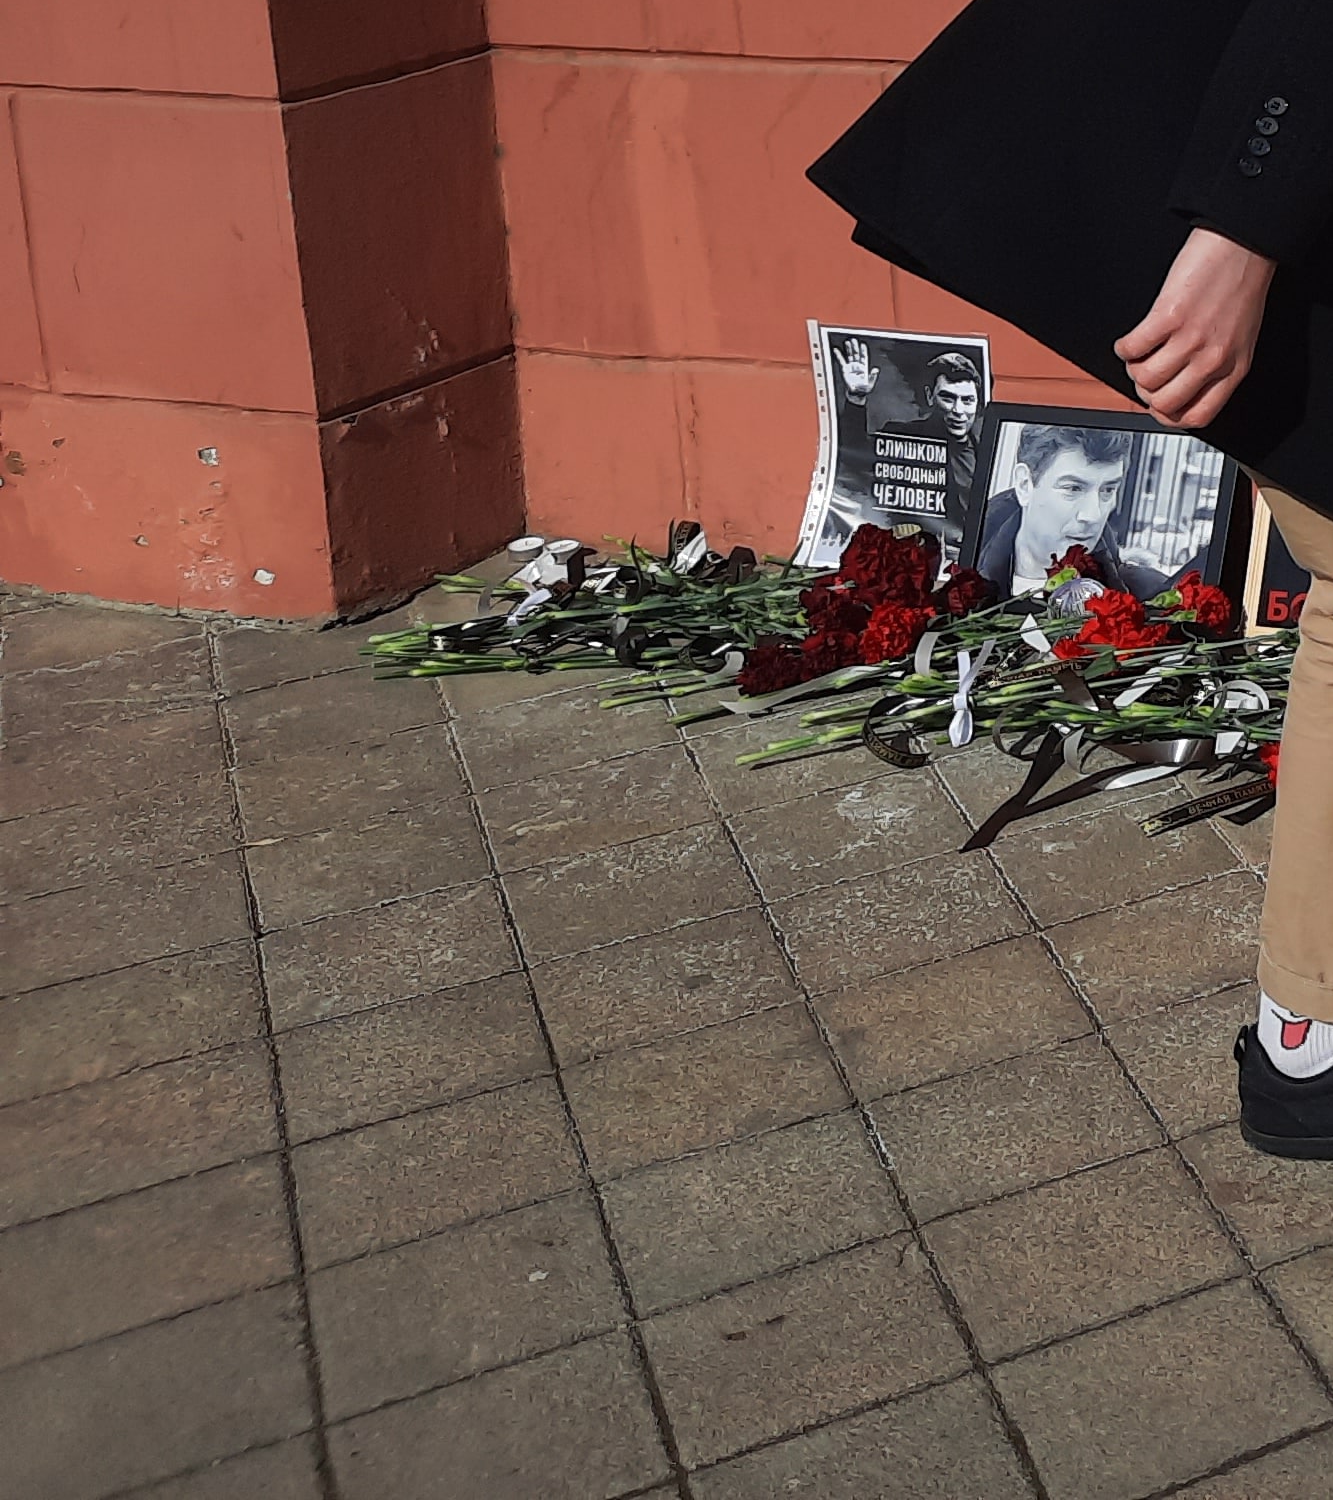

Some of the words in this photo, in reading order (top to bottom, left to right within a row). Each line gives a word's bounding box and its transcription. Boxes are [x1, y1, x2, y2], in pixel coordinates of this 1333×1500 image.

[876, 438, 947, 464] СЛИШКОМ
[875, 462, 946, 486] СВОБОДНЫЙ
[873, 483, 947, 512] ЧЕЛОВЕК
